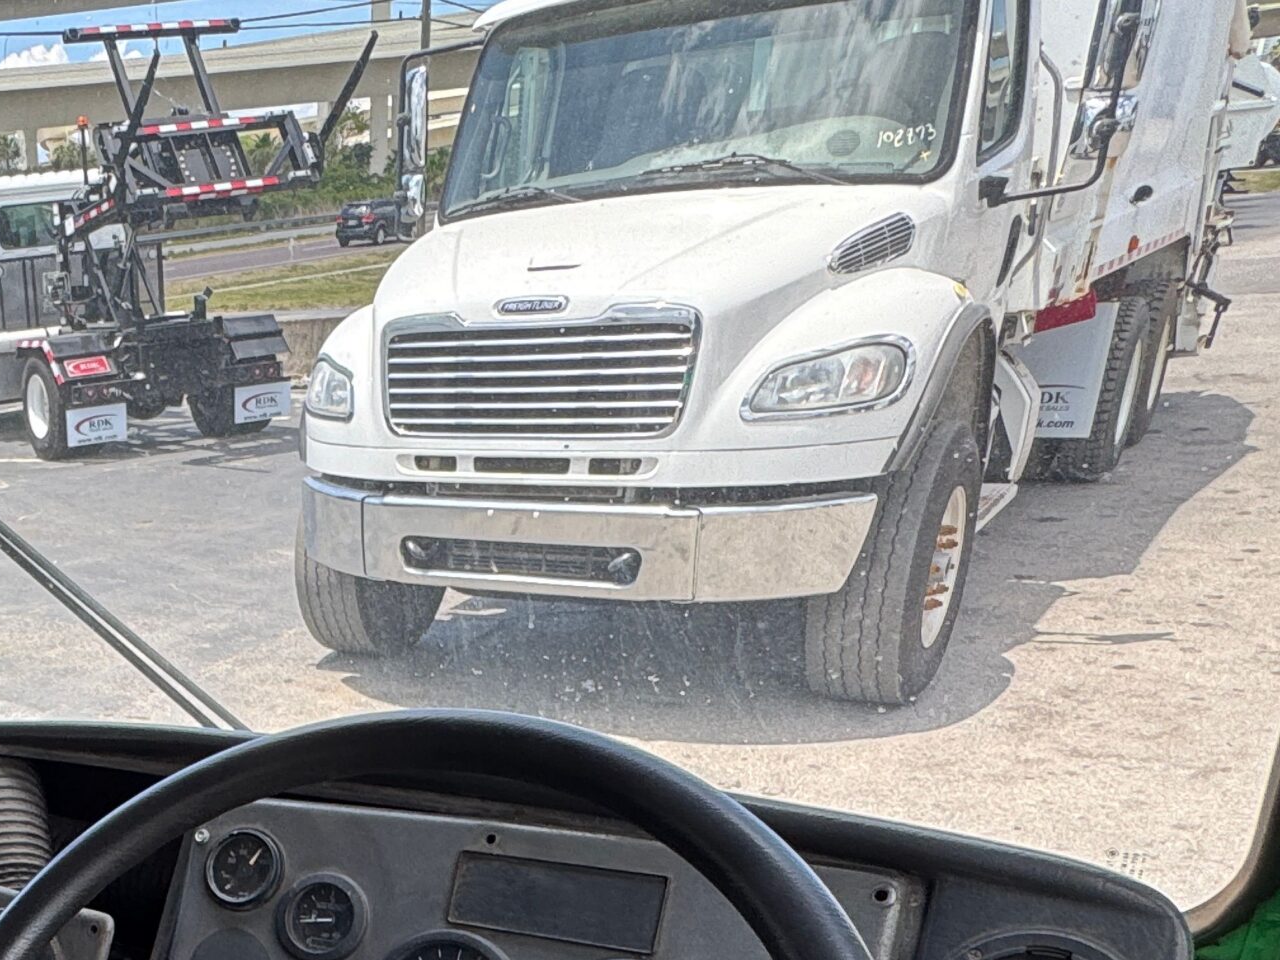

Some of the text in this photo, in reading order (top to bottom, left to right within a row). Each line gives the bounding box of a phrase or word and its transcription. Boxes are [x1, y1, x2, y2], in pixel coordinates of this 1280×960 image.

[503, 301, 561, 312] FREIGHTLINER
[256, 395, 277, 406] RDK
[1040, 391, 1069, 404] DK
[88, 418, 113, 429] RDK
